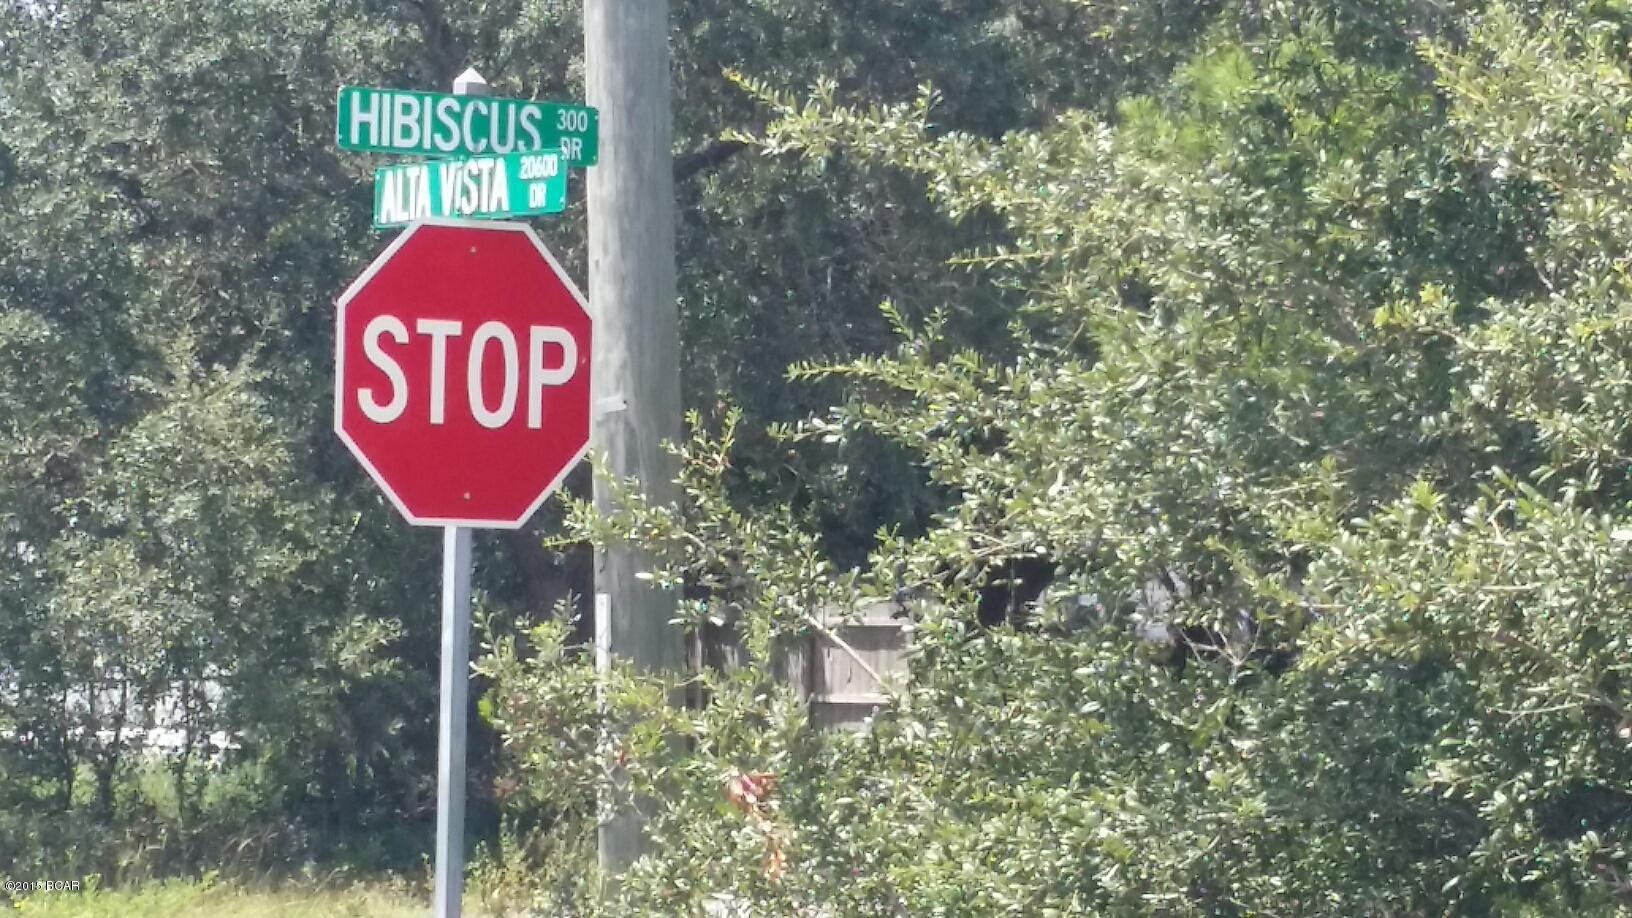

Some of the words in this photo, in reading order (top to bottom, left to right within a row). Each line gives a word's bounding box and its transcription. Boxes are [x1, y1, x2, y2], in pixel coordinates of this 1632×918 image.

[350, 91, 542, 154] HIBISCUS
[556, 109, 588, 132] 300
[561, 136, 582, 160] DR
[519, 154, 558, 179] 20600
[380, 165, 432, 223] ALTA
[440, 157, 510, 216] VISTA
[528, 183, 547, 208] DR
[357, 315, 578, 429] STOP
